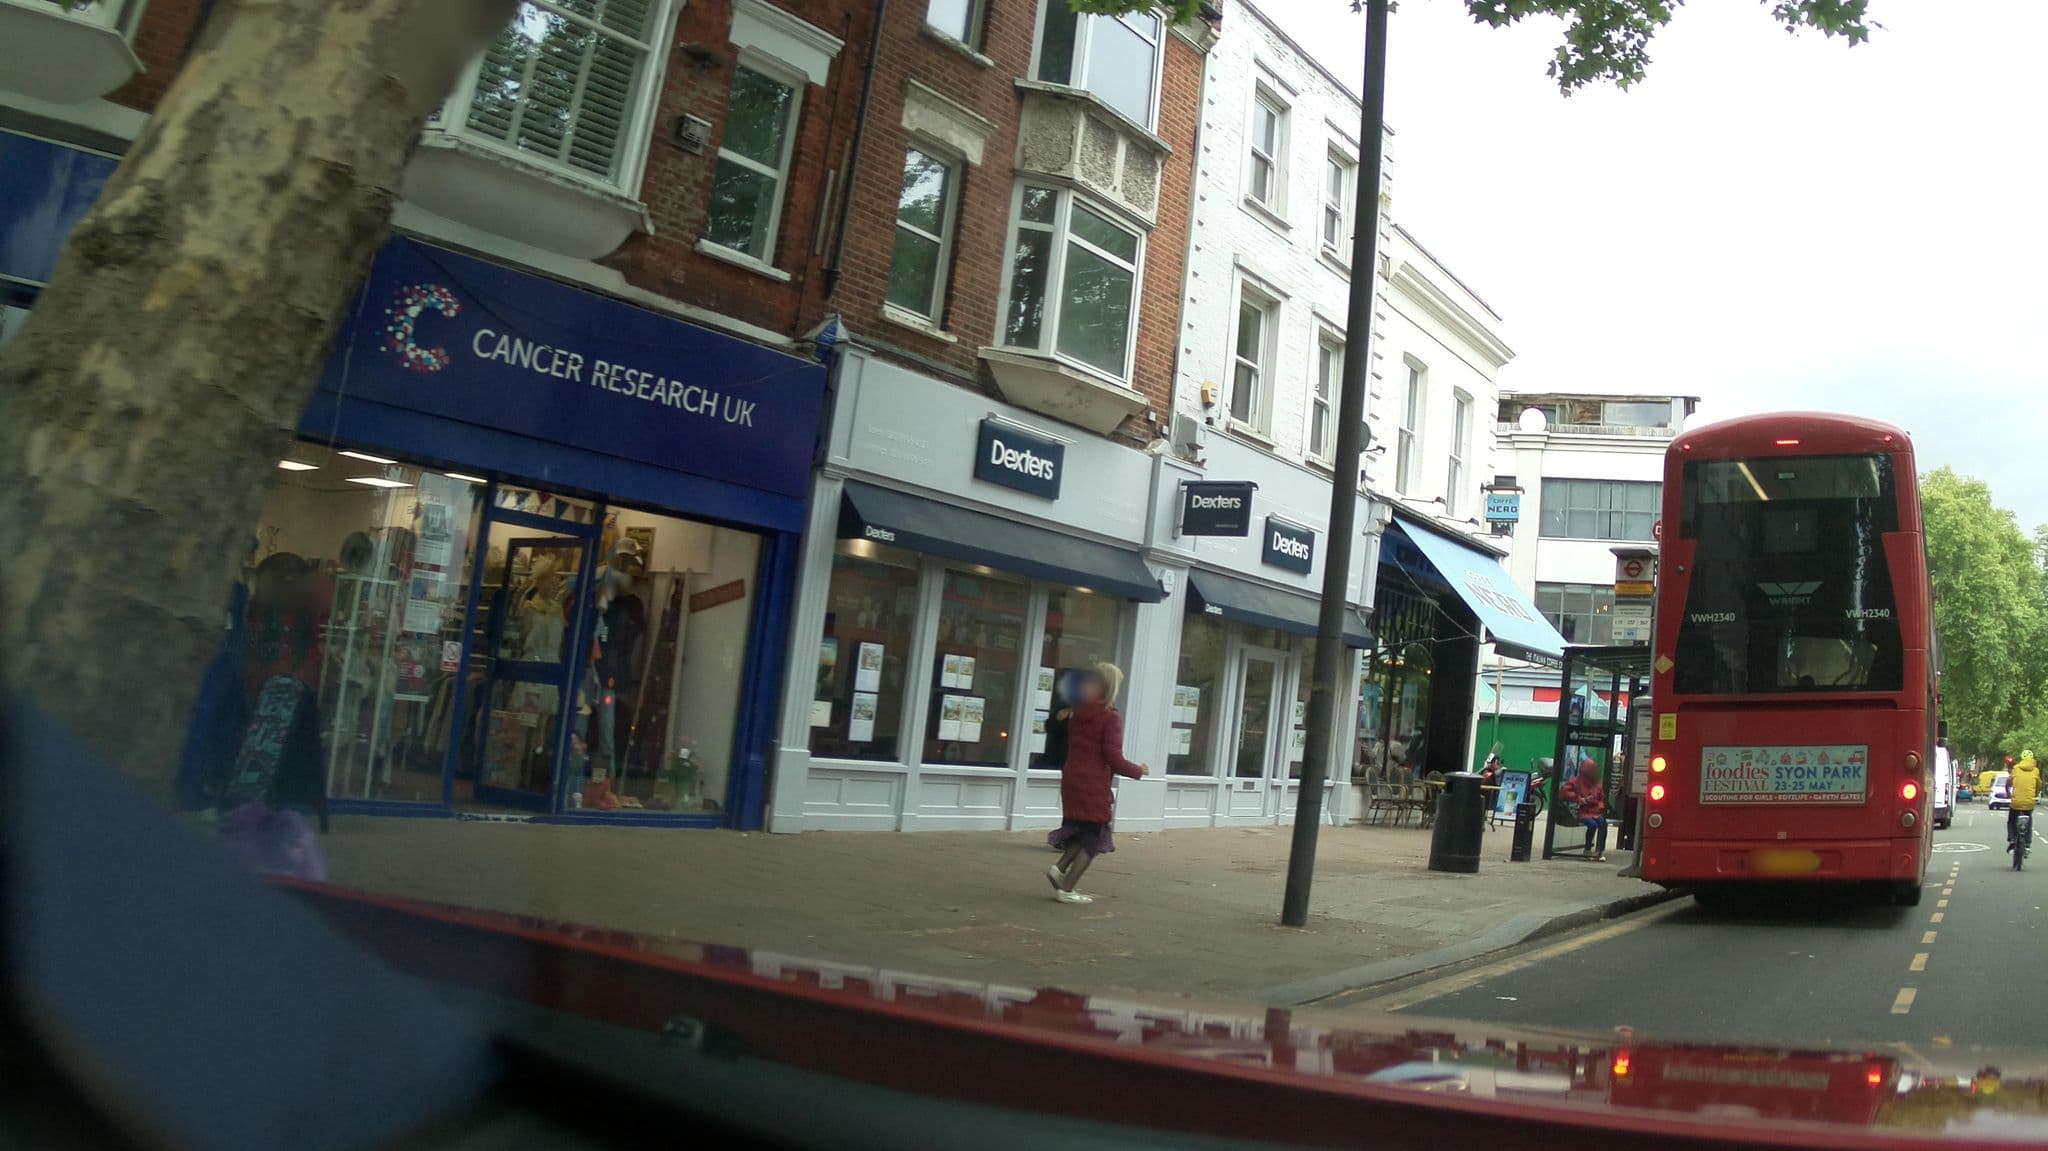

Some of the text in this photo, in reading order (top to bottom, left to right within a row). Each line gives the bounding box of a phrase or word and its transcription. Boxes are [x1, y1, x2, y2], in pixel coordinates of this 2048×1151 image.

[472, 329, 757, 427] CANCER RESEARCH UK
[990, 439, 1055, 481] Dexters
[1191, 494, 1242, 509] Dexters
[1488, 505, 1518, 513] NERO
[865, 525, 896, 542] Dexters
[1272, 531, 1310, 560] Dexters
[1691, 612, 1736, 623] VWH2340
[1845, 608, 1890, 619] VWH2340
[1706, 762, 1769, 780] foodies
[1775, 765, 1863, 779] SYON PARK
[1705, 780, 1769, 791] FESTIVAL
[1774, 781, 1833, 791] 23-25 MAY
